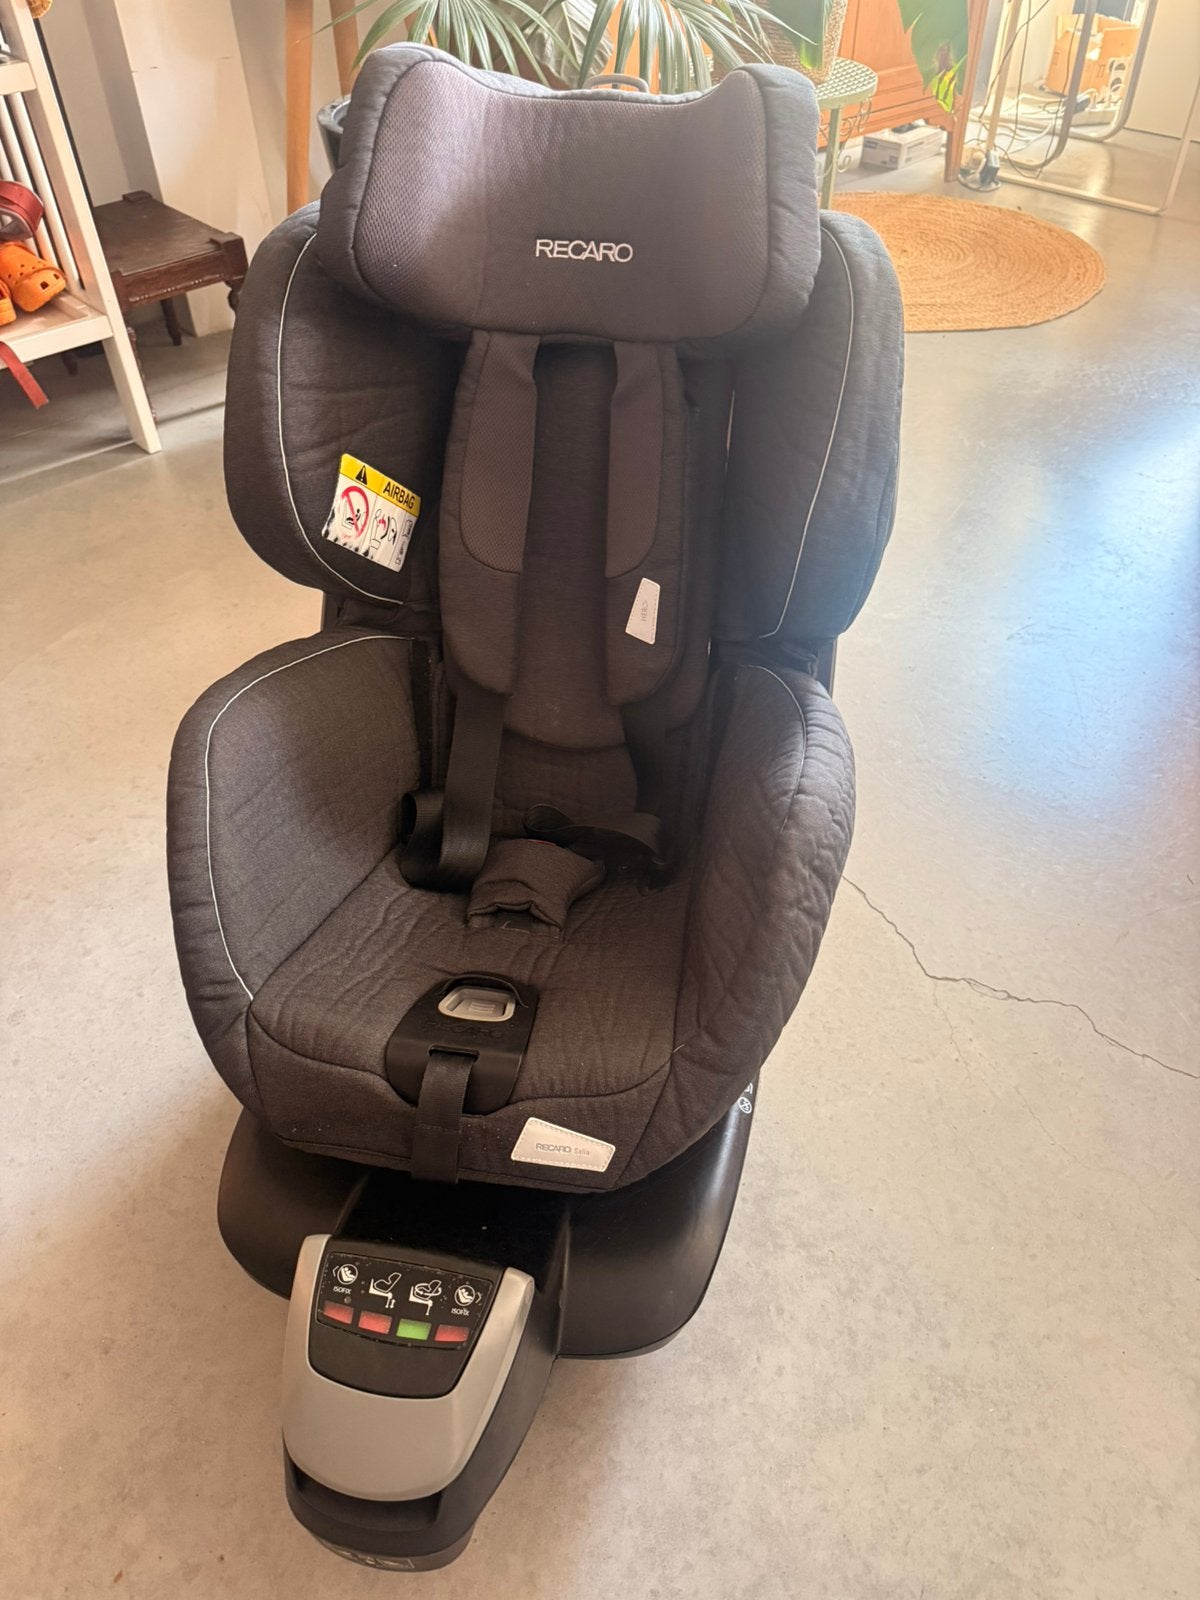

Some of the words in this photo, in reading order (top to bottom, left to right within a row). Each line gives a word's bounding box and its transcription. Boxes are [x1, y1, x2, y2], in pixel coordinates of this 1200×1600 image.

[535, 239, 633, 262] RECARO
[383, 481, 415, 509] AIRBAG
[640, 600, 648, 621] HERO
[535, 1142, 572, 1153] RECARO
[333, 1285, 352, 1294] ISOFIX
[451, 1307, 470, 1316] ISOFIX
